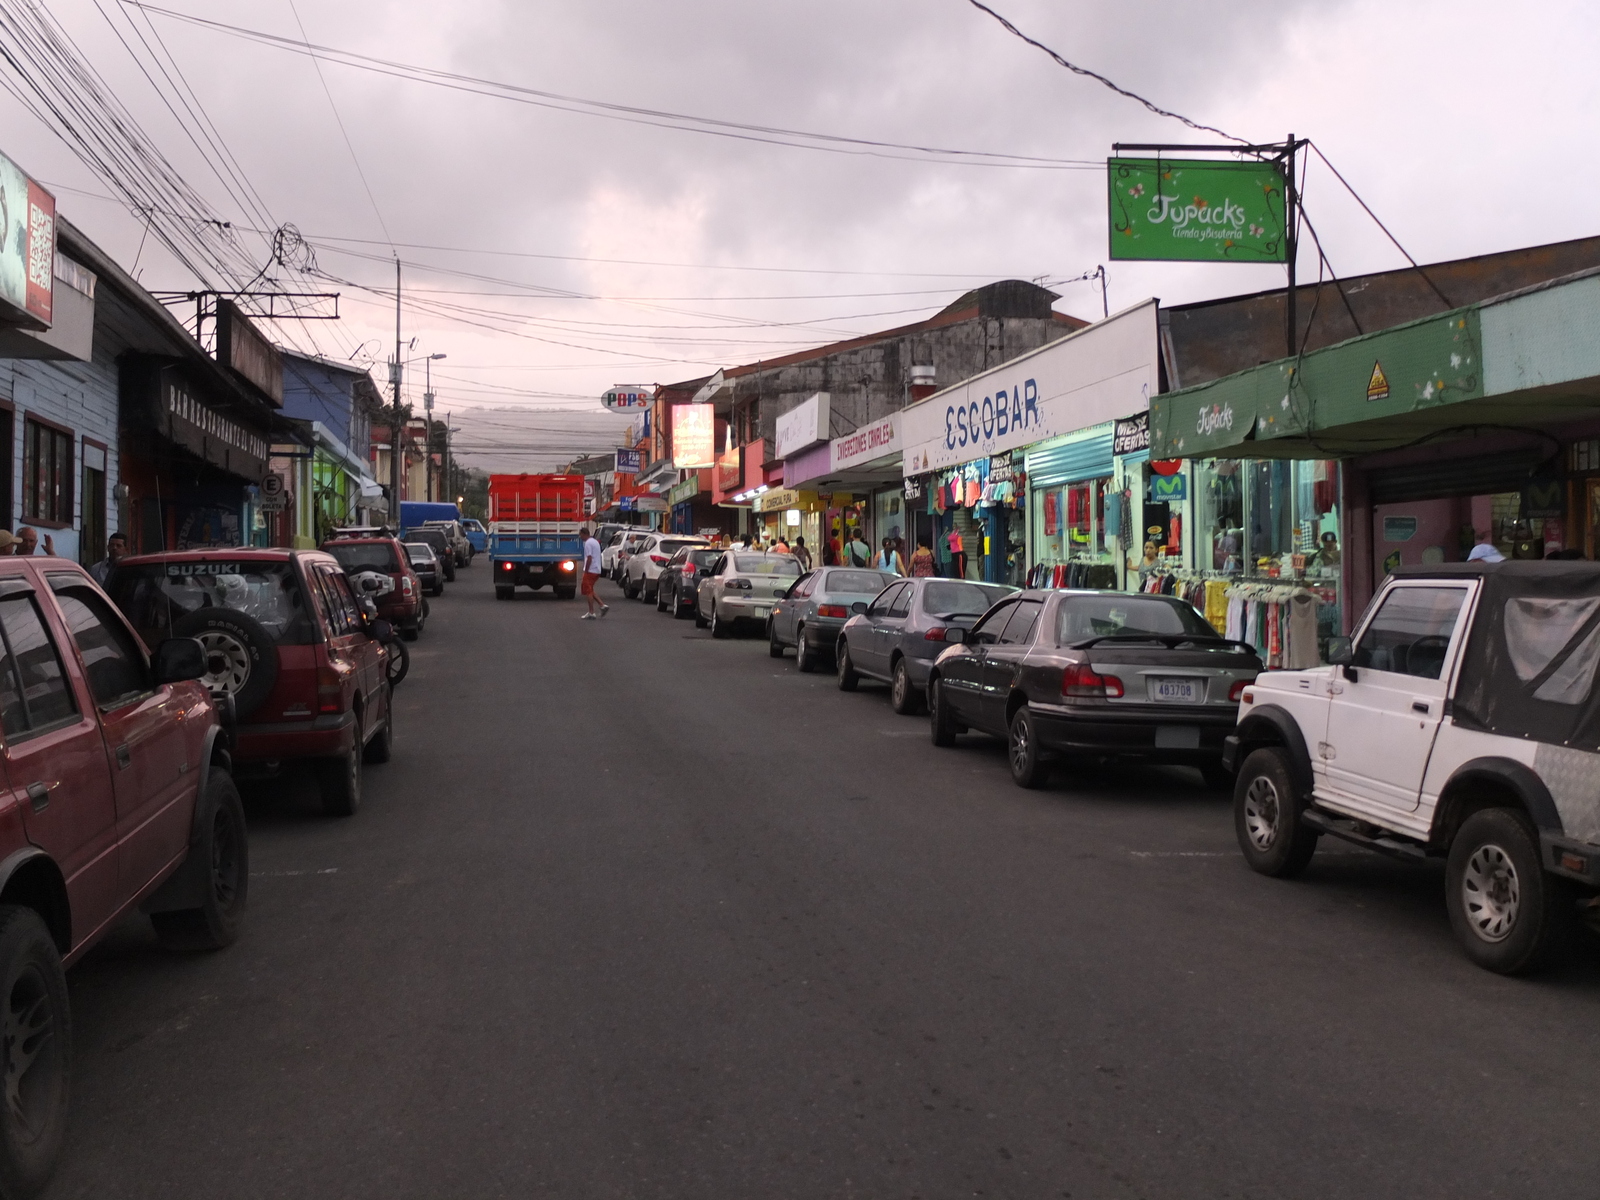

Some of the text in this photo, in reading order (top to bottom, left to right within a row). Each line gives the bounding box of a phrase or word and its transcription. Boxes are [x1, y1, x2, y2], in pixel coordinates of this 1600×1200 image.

[1172, 227, 1199, 238] Tienda
[607, 393, 647, 407] POPS
[169, 385, 188, 420] BAR
[190, 398, 241, 447] RESTAURANTE
[946, 378, 1038, 450] ESCOBAR
[1117, 421, 1138, 436] MES
[837, 424, 889, 461] INVERSIONES CANALES
[1114, 430, 1150, 452] OFERTAS
[991, 457, 1004, 468] MES
[990, 465, 1012, 481] OFERTAS
[267, 479, 277, 490] E
[766, 496, 783, 509] COMERCIAL
[168, 564, 241, 576] SUZUKI
[208, 620, 249, 642] RADIAL
[1159, 685, 1192, 696] 483708
